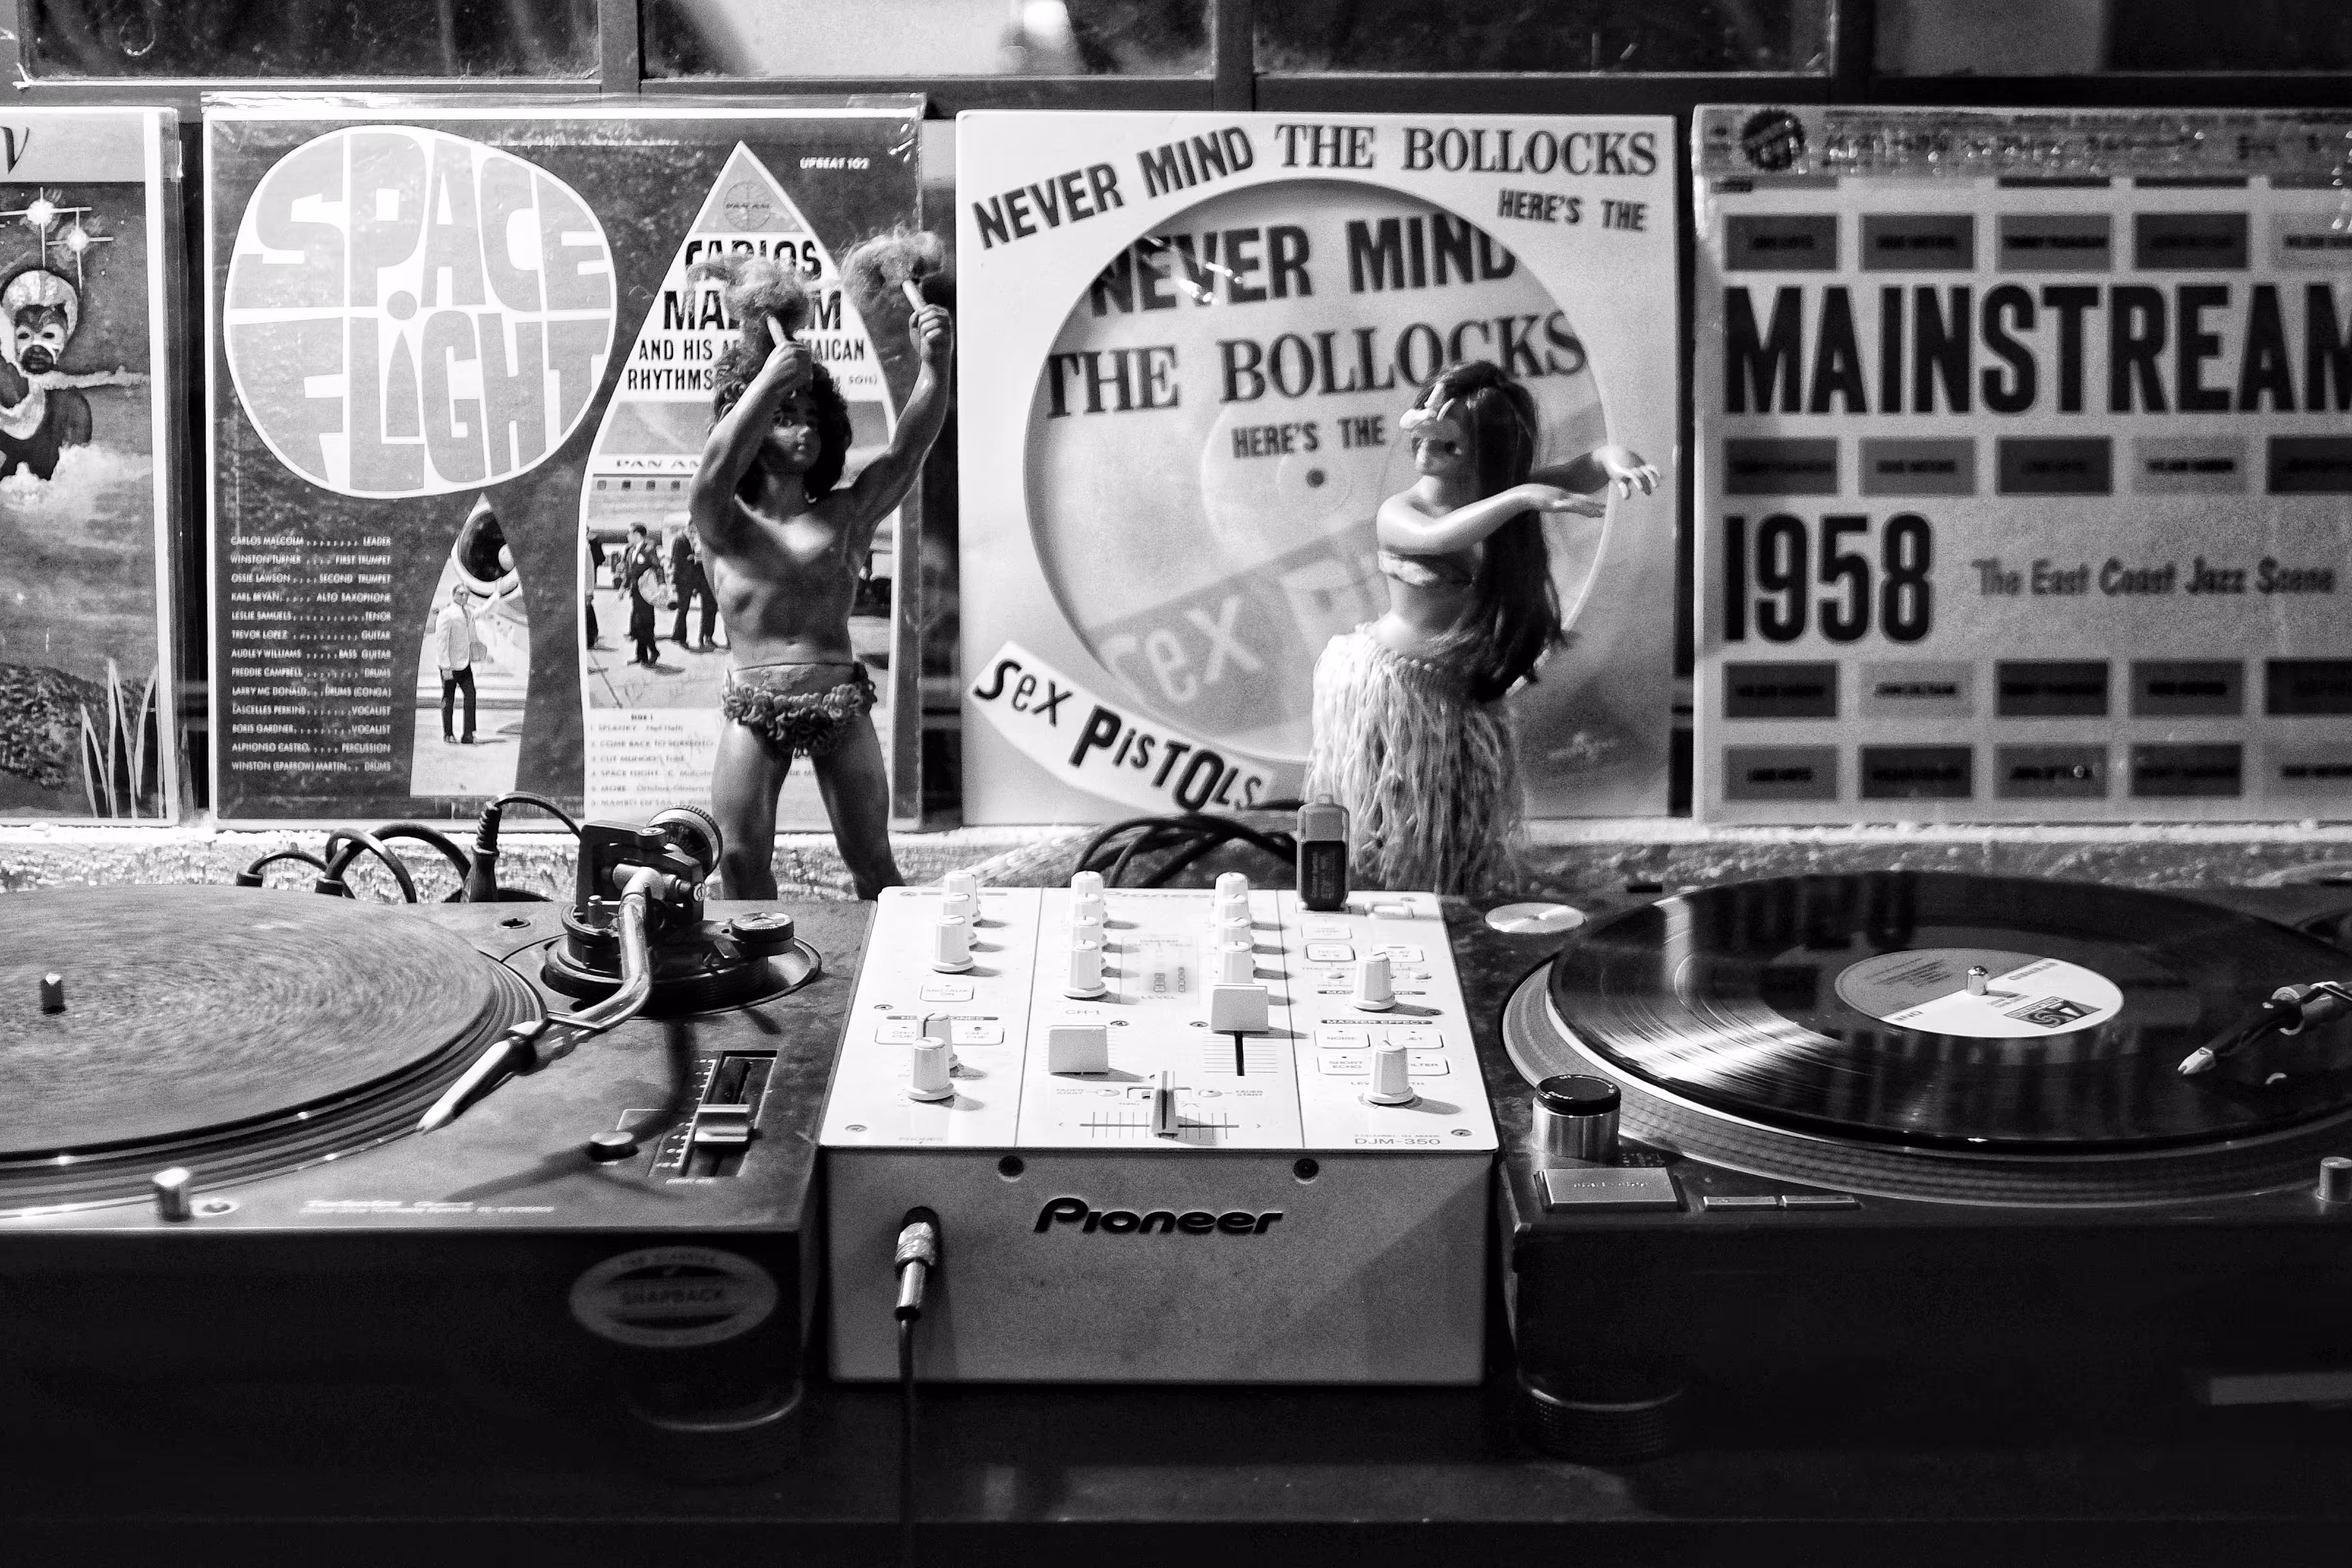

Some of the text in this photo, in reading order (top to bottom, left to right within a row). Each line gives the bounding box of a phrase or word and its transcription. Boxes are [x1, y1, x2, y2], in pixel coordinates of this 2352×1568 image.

[229, 133, 611, 312] SPACE
[972, 124, 1657, 250] NEVER MIND THE BOLLOCKS
[1497, 189, 1647, 231] HERE'S THE
[1091, 213, 1516, 317] NEVER MIND
[628, 369, 714, 390] RHYTHMS
[639, 340, 674, 361] AND
[684, 340, 713, 361] HIS
[1047, 310, 1587, 418] THE BOLLOCKS
[1337, 414, 1387, 448] THE
[1724, 513, 1931, 644] 1958
[1033, 1197, 1284, 1234] Pioneer
